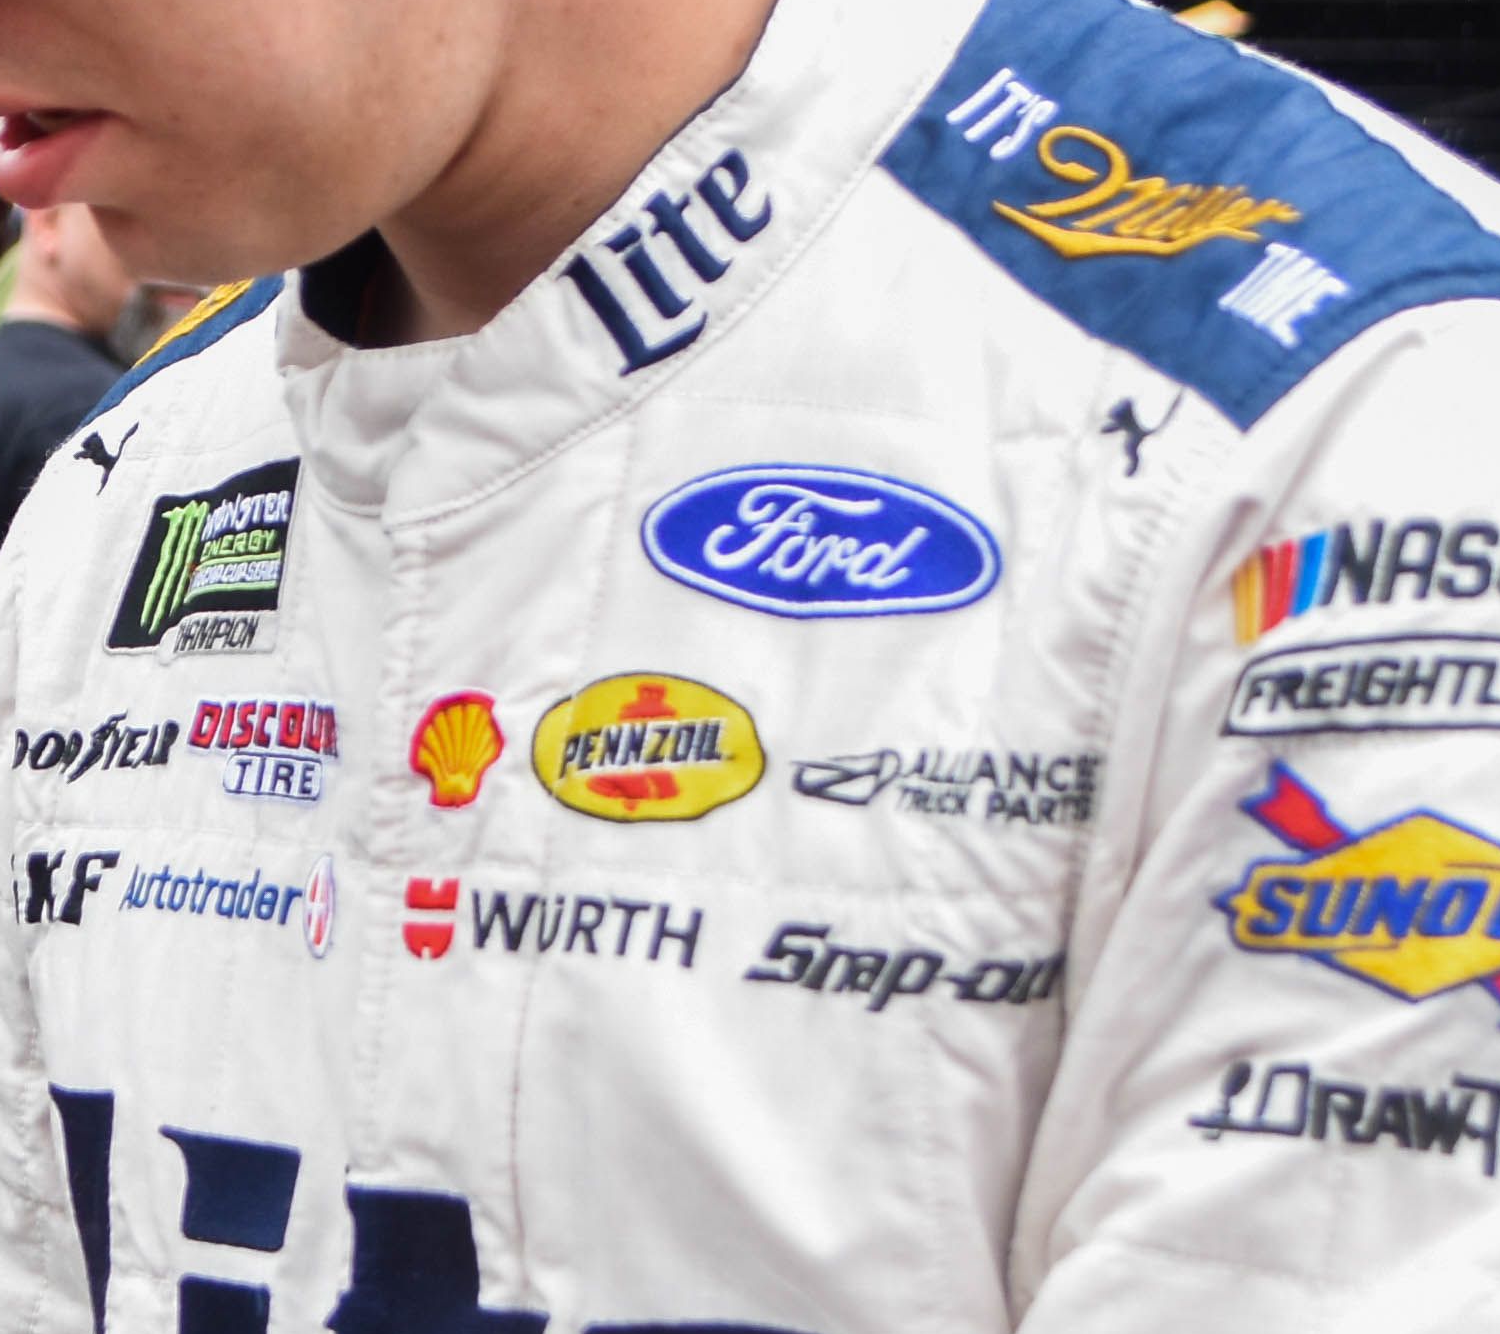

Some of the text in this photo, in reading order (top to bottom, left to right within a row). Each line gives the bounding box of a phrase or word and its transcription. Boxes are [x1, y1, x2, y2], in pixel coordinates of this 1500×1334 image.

[561, 145, 775, 379] Lite
[992, 124, 1304, 260] Miller
[1217, 241, 1352, 350] TIME
[701, 477, 930, 595] Ford
[174, 615, 260, 654] HAMPION
[233, 758, 322, 798] TIRE
[556, 713, 737, 781] PENNZOIL
[11, 848, 122, 927] KF
[743, 920, 1068, 1013] Snap-on
